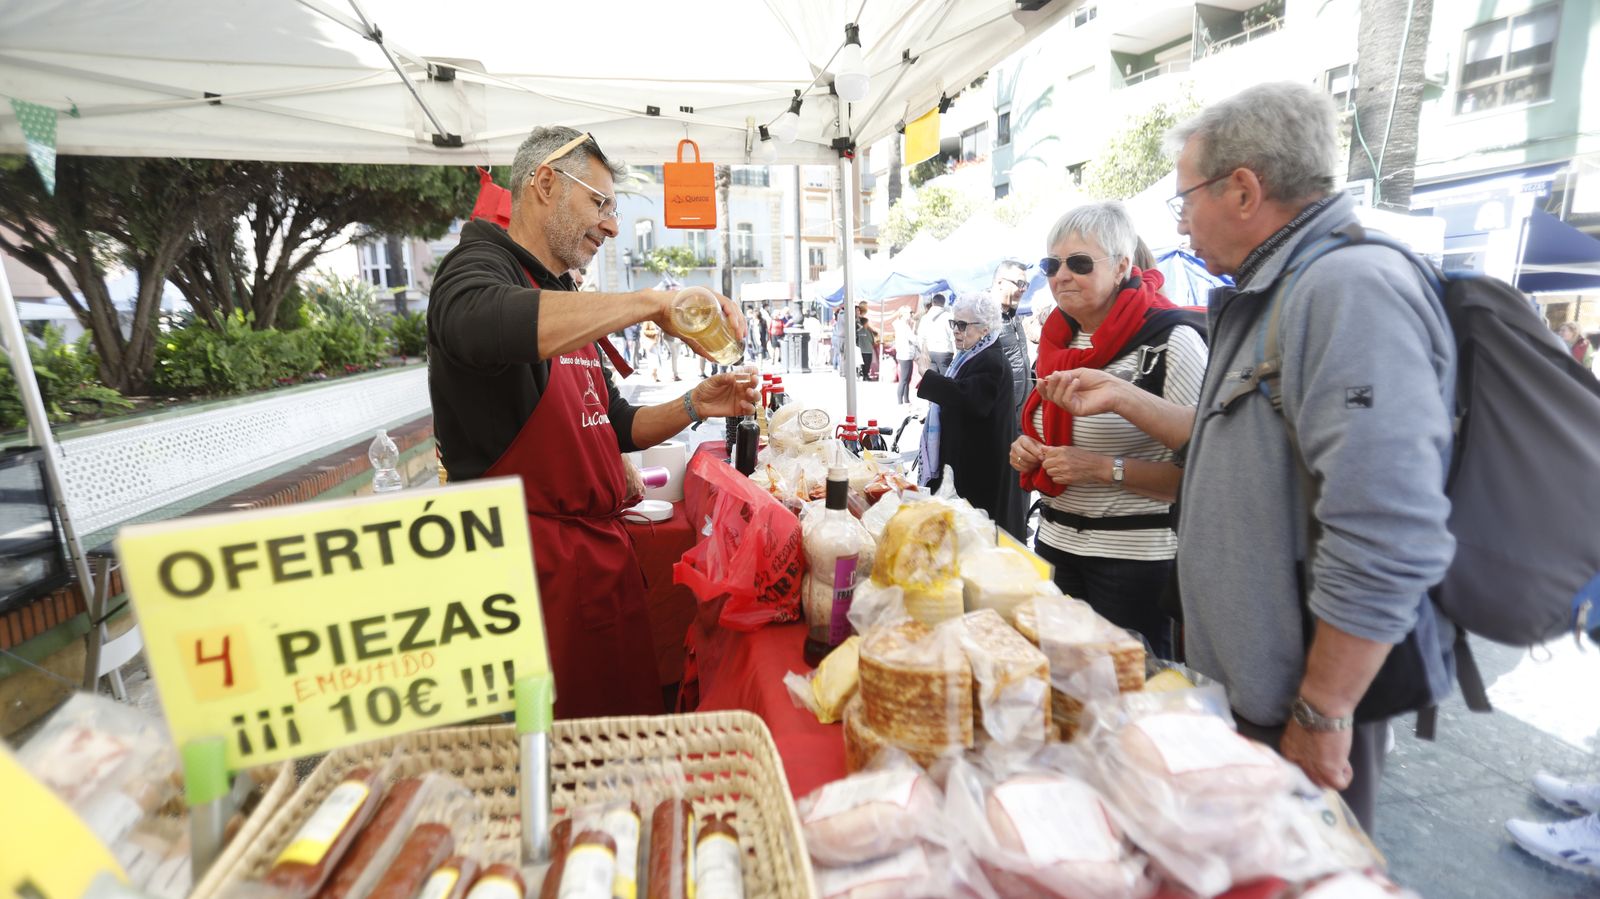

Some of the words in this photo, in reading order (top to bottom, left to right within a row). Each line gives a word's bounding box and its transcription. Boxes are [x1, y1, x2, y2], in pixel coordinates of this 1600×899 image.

[158, 501, 506, 599] OFERTÓN
[194, 634, 235, 688] 4
[277, 593, 522, 676] PIEZAS
[293, 651, 435, 704] EMBUTIDO
[328, 677, 442, 733] 10€
